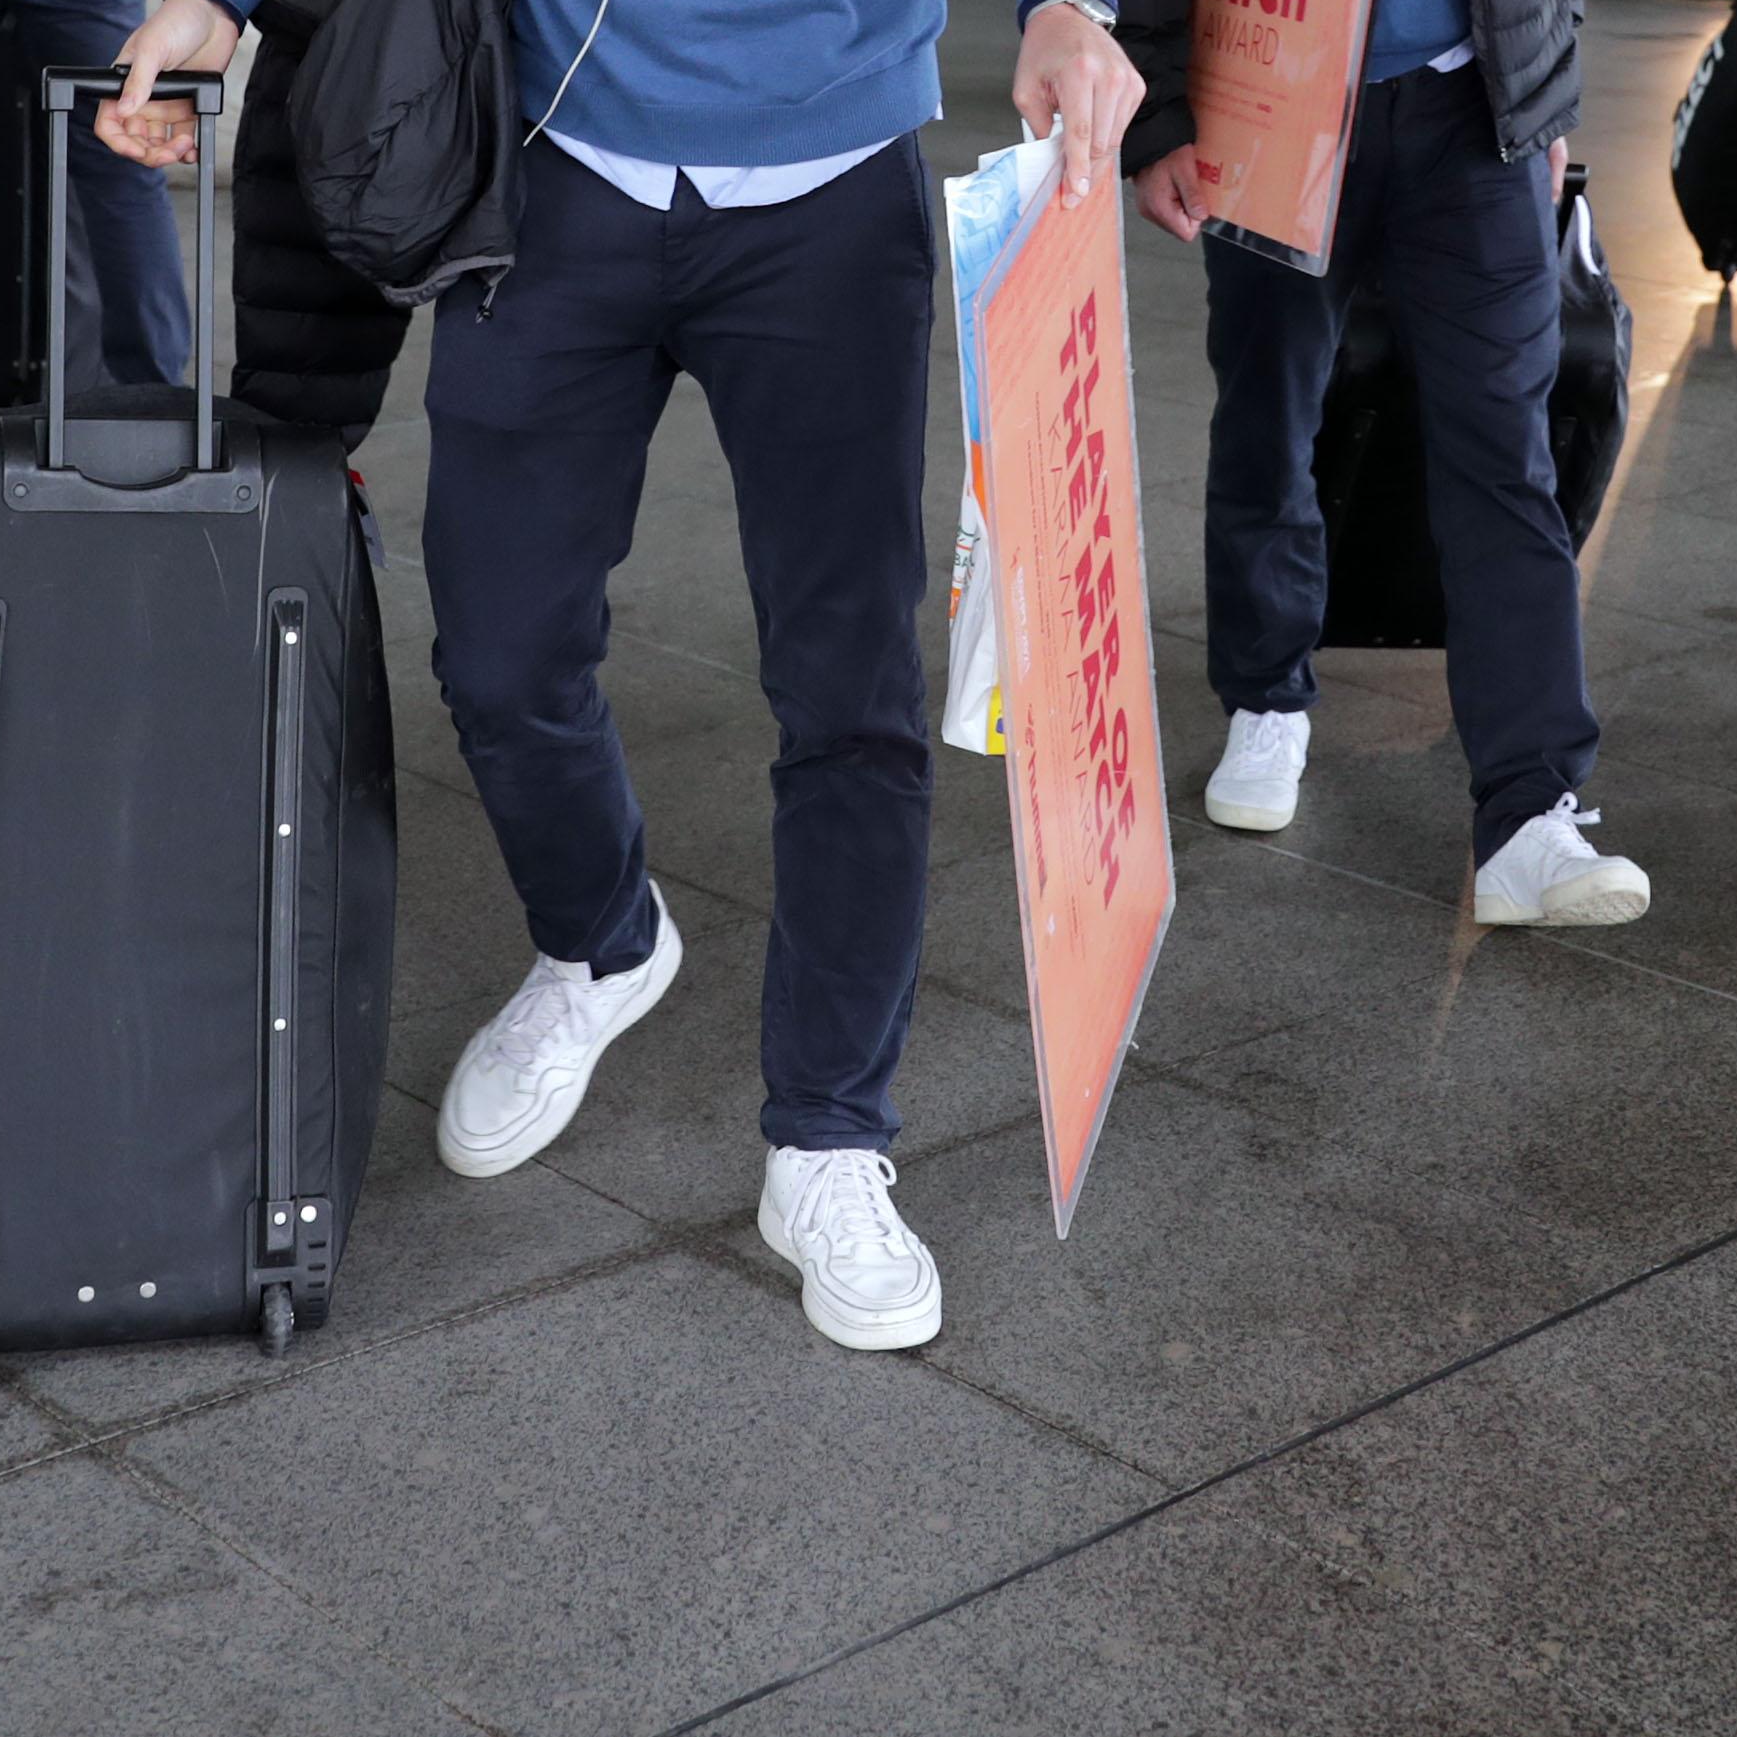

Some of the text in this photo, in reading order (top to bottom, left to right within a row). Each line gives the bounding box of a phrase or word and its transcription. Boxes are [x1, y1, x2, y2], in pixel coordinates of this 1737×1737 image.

[1201, 13, 1279, 65] AWARD
[1060, 306, 1120, 910] THE MATCH
[1079, 286, 1135, 841] PLAYER OF
